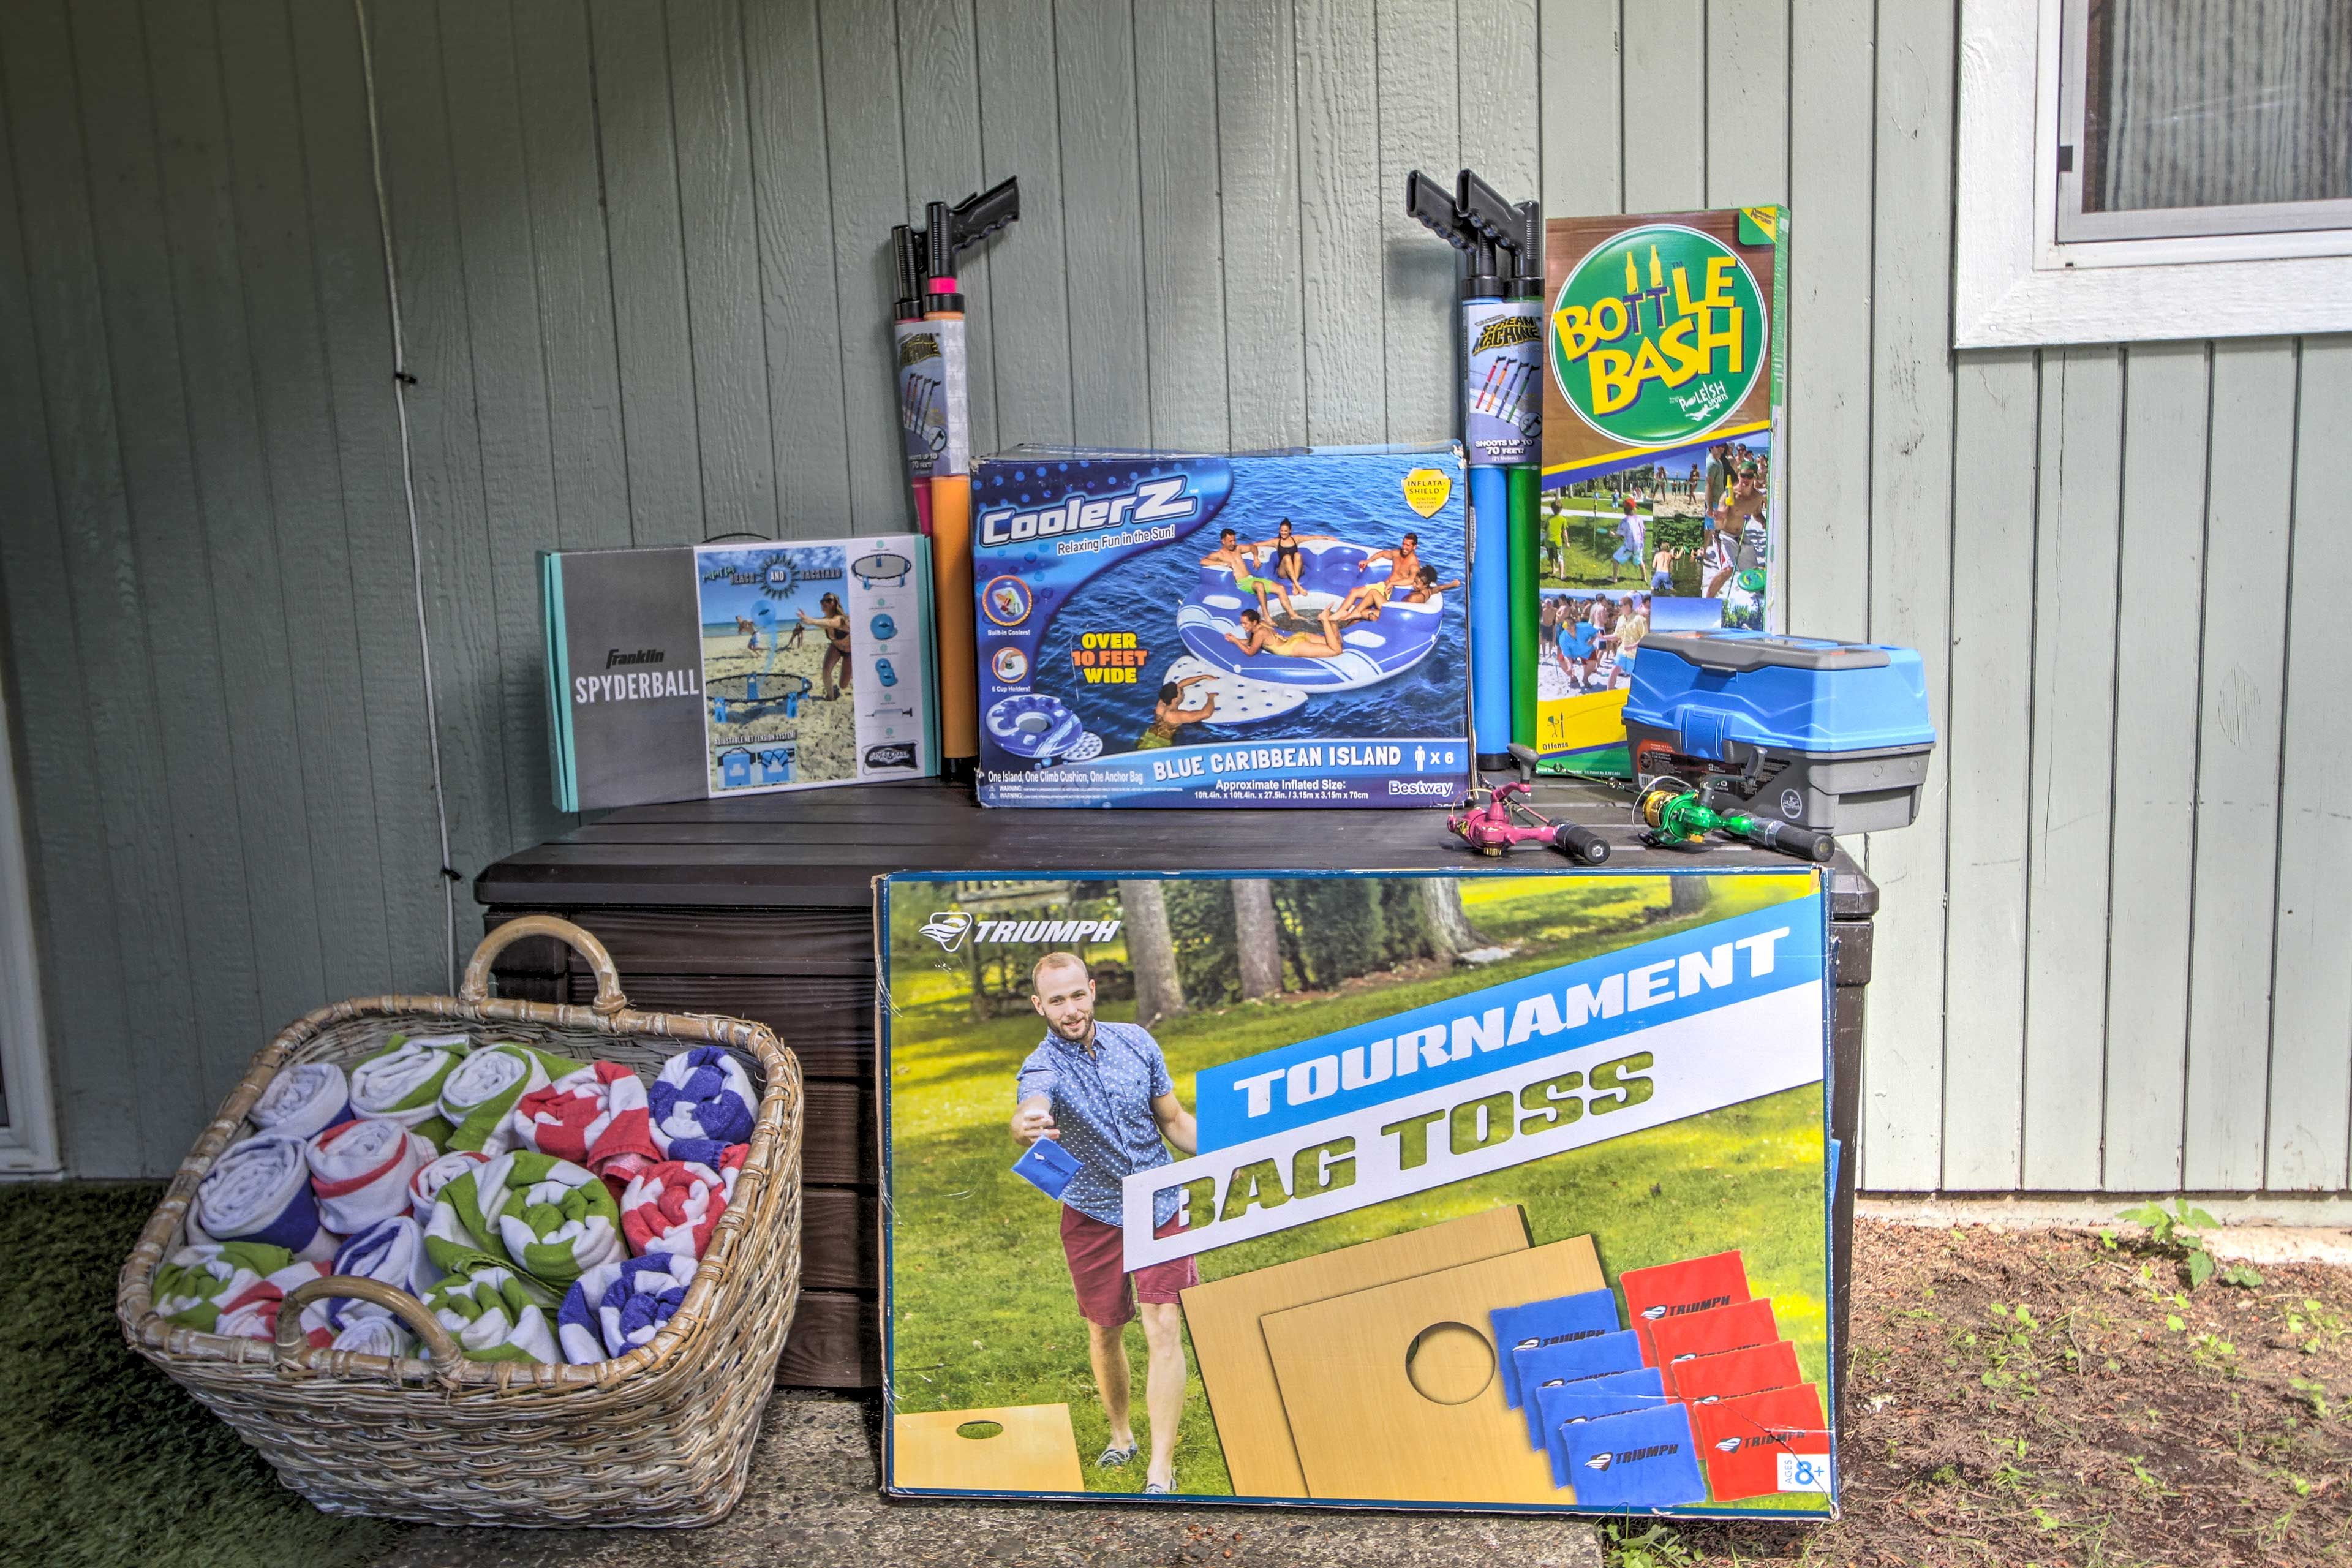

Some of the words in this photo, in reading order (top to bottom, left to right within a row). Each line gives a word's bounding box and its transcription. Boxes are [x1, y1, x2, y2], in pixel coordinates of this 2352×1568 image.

[1552, 257, 1737, 361] BOTTLE
[1588, 307, 1744, 417] BASH
[1708, 393, 1728, 407] SPORTS
[1486, 446, 1500, 454] 70
[1058, 538, 1099, 556] Relaxing
[1101, 536, 1120, 548] Fun
[1122, 533, 1133, 545] in
[1134, 530, 1150, 543] the
[1152, 525, 1175, 541] Sun!
[770, 571, 785, 581] AND
[1082, 633, 1137, 649] OVER
[1072, 651, 1095, 666] 10
[1099, 651, 1147, 666] FEET
[1083, 668, 1137, 684] WIDE
[575, 669, 699, 704] SPYDERBALL
[715, 736, 744, 745] ADJUSTABLE
[745, 735, 753, 744] NET
[755, 733, 775, 742] TENSION
[776, 730, 796, 740] SYSTEM!
[1542, 741, 1569, 751] Offense
[1153, 756, 1206, 782] BLUE
[1210, 747, 1322, 773] CARIBBEAN
[1329, 745, 1401, 766] ISLAND
[1444, 751, 1455, 765] 6
[988, 772, 1001, 783] One
[1002, 771, 1024, 784] Island,
[1025, 771, 1039, 782] One
[1039, 771, 1059, 782] Climb
[1060, 770, 1089, 785] Cushion,
[1090, 771, 1104, 782] One
[1104, 770, 1129, 782] Anchor
[1130, 771, 1144, 785] Bag
[1215, 779, 1279, 791] Approximate
[1282, 778, 1321, 790] Inflated
[1322, 778, 1346, 790] Size:
[974, 920, 1121, 943] TRIUMPH
[1234, 926, 1791, 1118] TOURNAMENT
[1153, 1136, 1357, 1240] BAG
[1381, 1051, 1654, 1172] TOSS
[1670, 1295, 1730, 1316] TRIUMPH
[1616, 1444, 1678, 1464] TRIUMPH
[1795, 1461, 1825, 1485] 8+
